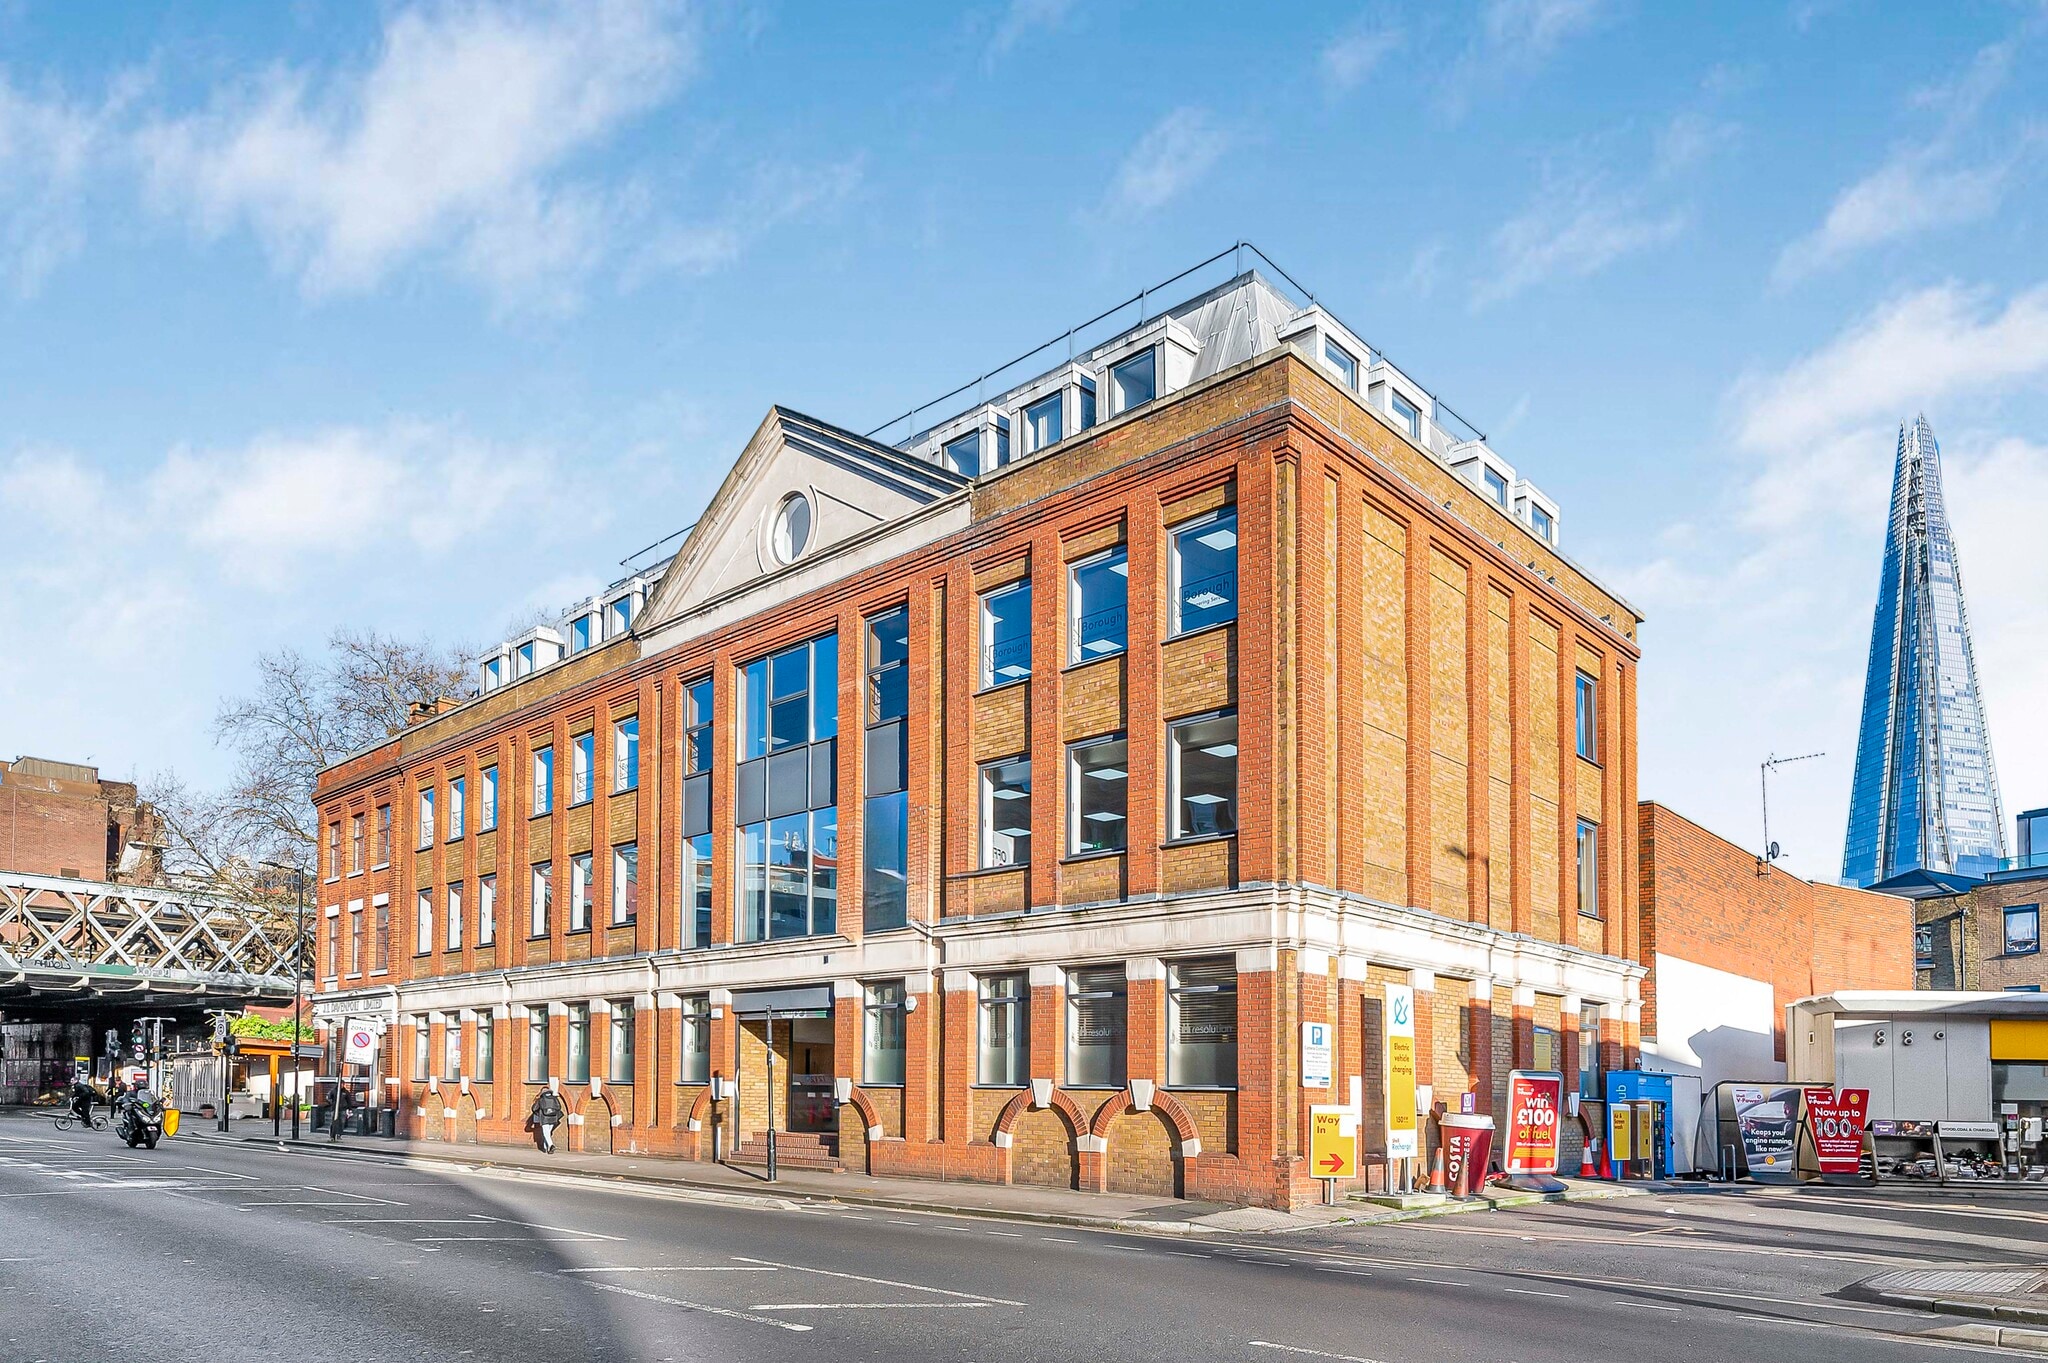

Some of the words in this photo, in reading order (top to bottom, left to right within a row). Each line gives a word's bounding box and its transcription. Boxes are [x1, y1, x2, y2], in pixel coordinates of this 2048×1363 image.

[1183, 578, 1230, 601] Borough
[1082, 611, 1123, 632] Borough
[1394, 1042, 1410, 1051] Electric
[1394, 1054, 1410, 1062] vehicle
[1391, 1065, 1412, 1075] charging
[1525, 1093, 1549, 1108] win
[1516, 1108, 1555, 1126] £100
[1815, 1107, 1837, 1117] Now
[1838, 1110, 1850, 1118] up
[1851, 1109, 1860, 1117] to
[1316, 1115, 1340, 1126] Way
[1316, 1126, 1326, 1134] In
[1519, 1126, 1531, 1139] of
[1532, 1126, 1550, 1140] fuel
[1750, 1128, 1771, 1137] Keeps
[1772, 1129, 1786, 1137] your
[1745, 1137, 1768, 1146] engine
[1768, 1137, 1792, 1146] running
[1756, 1144, 1767, 1152] like
[1448, 1136, 1461, 1182] COSTA
